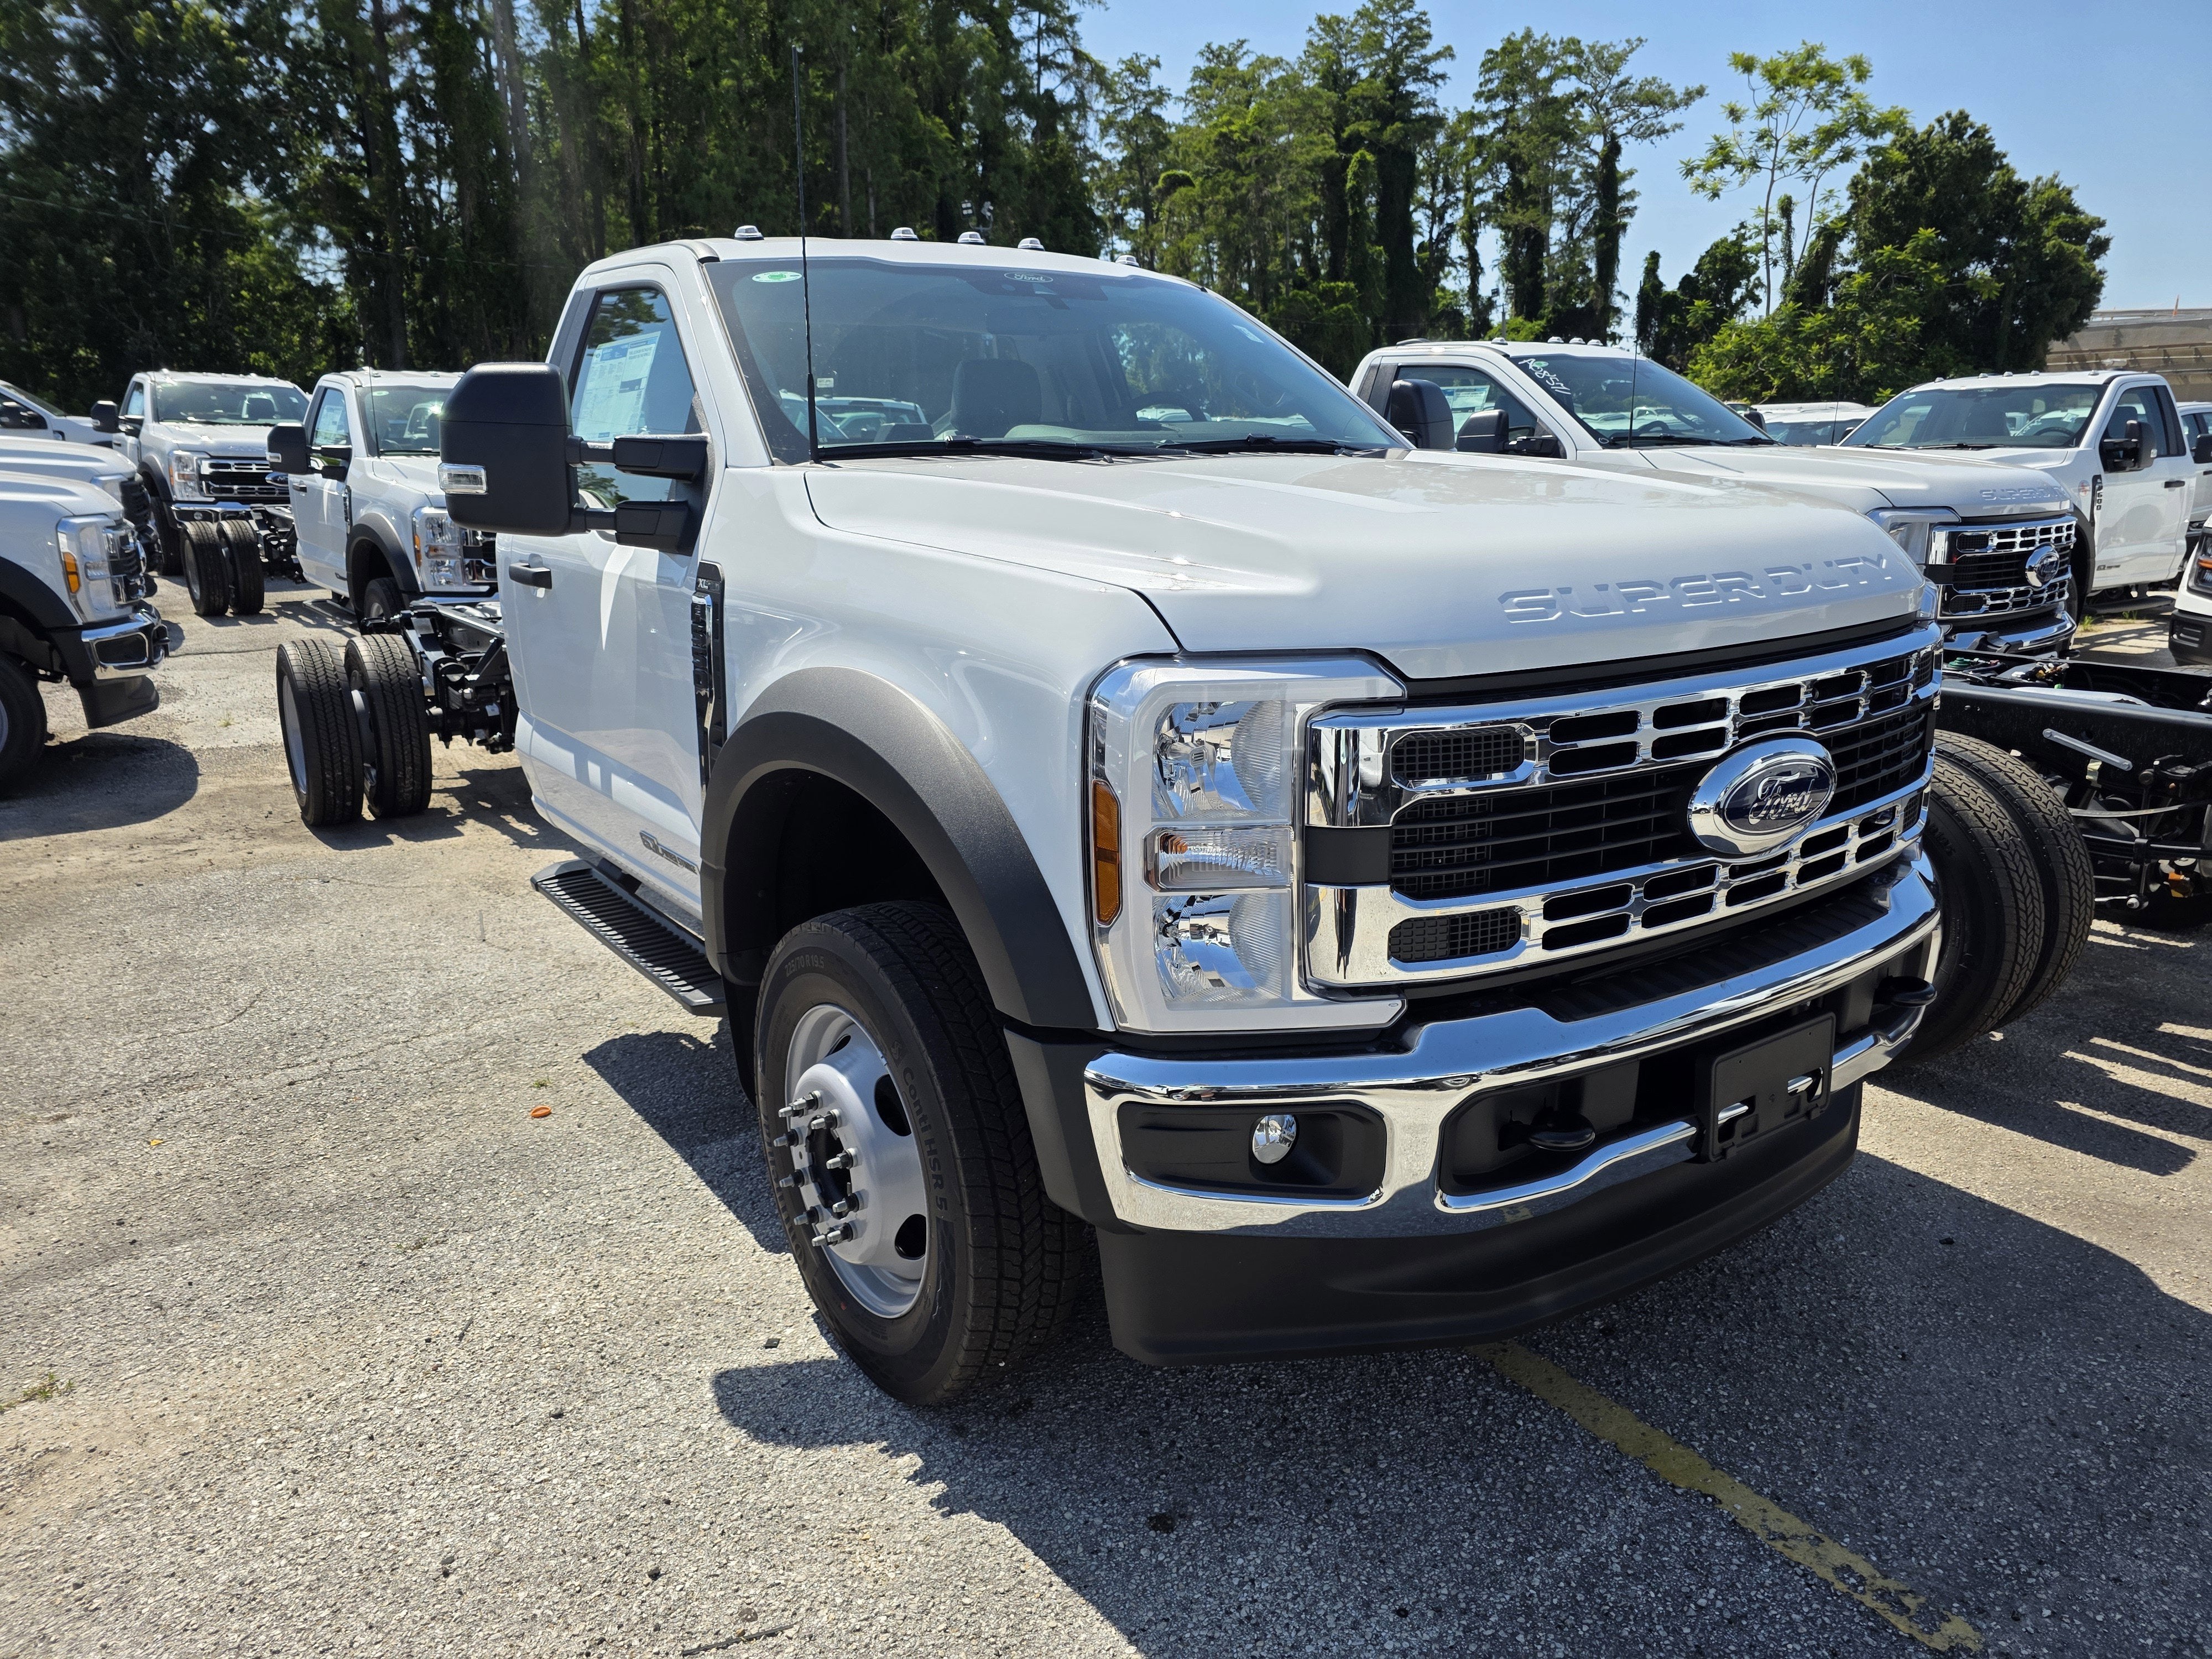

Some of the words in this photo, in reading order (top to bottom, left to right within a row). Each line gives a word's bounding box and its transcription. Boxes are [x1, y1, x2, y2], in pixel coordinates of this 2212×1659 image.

[698, 578, 708, 589] XL
[1748, 772, 1815, 825] Ford
[902, 1067, 932, 1134] Conti
[924, 1138, 944, 1190] HSR
[936, 1195, 948, 1211] 5
